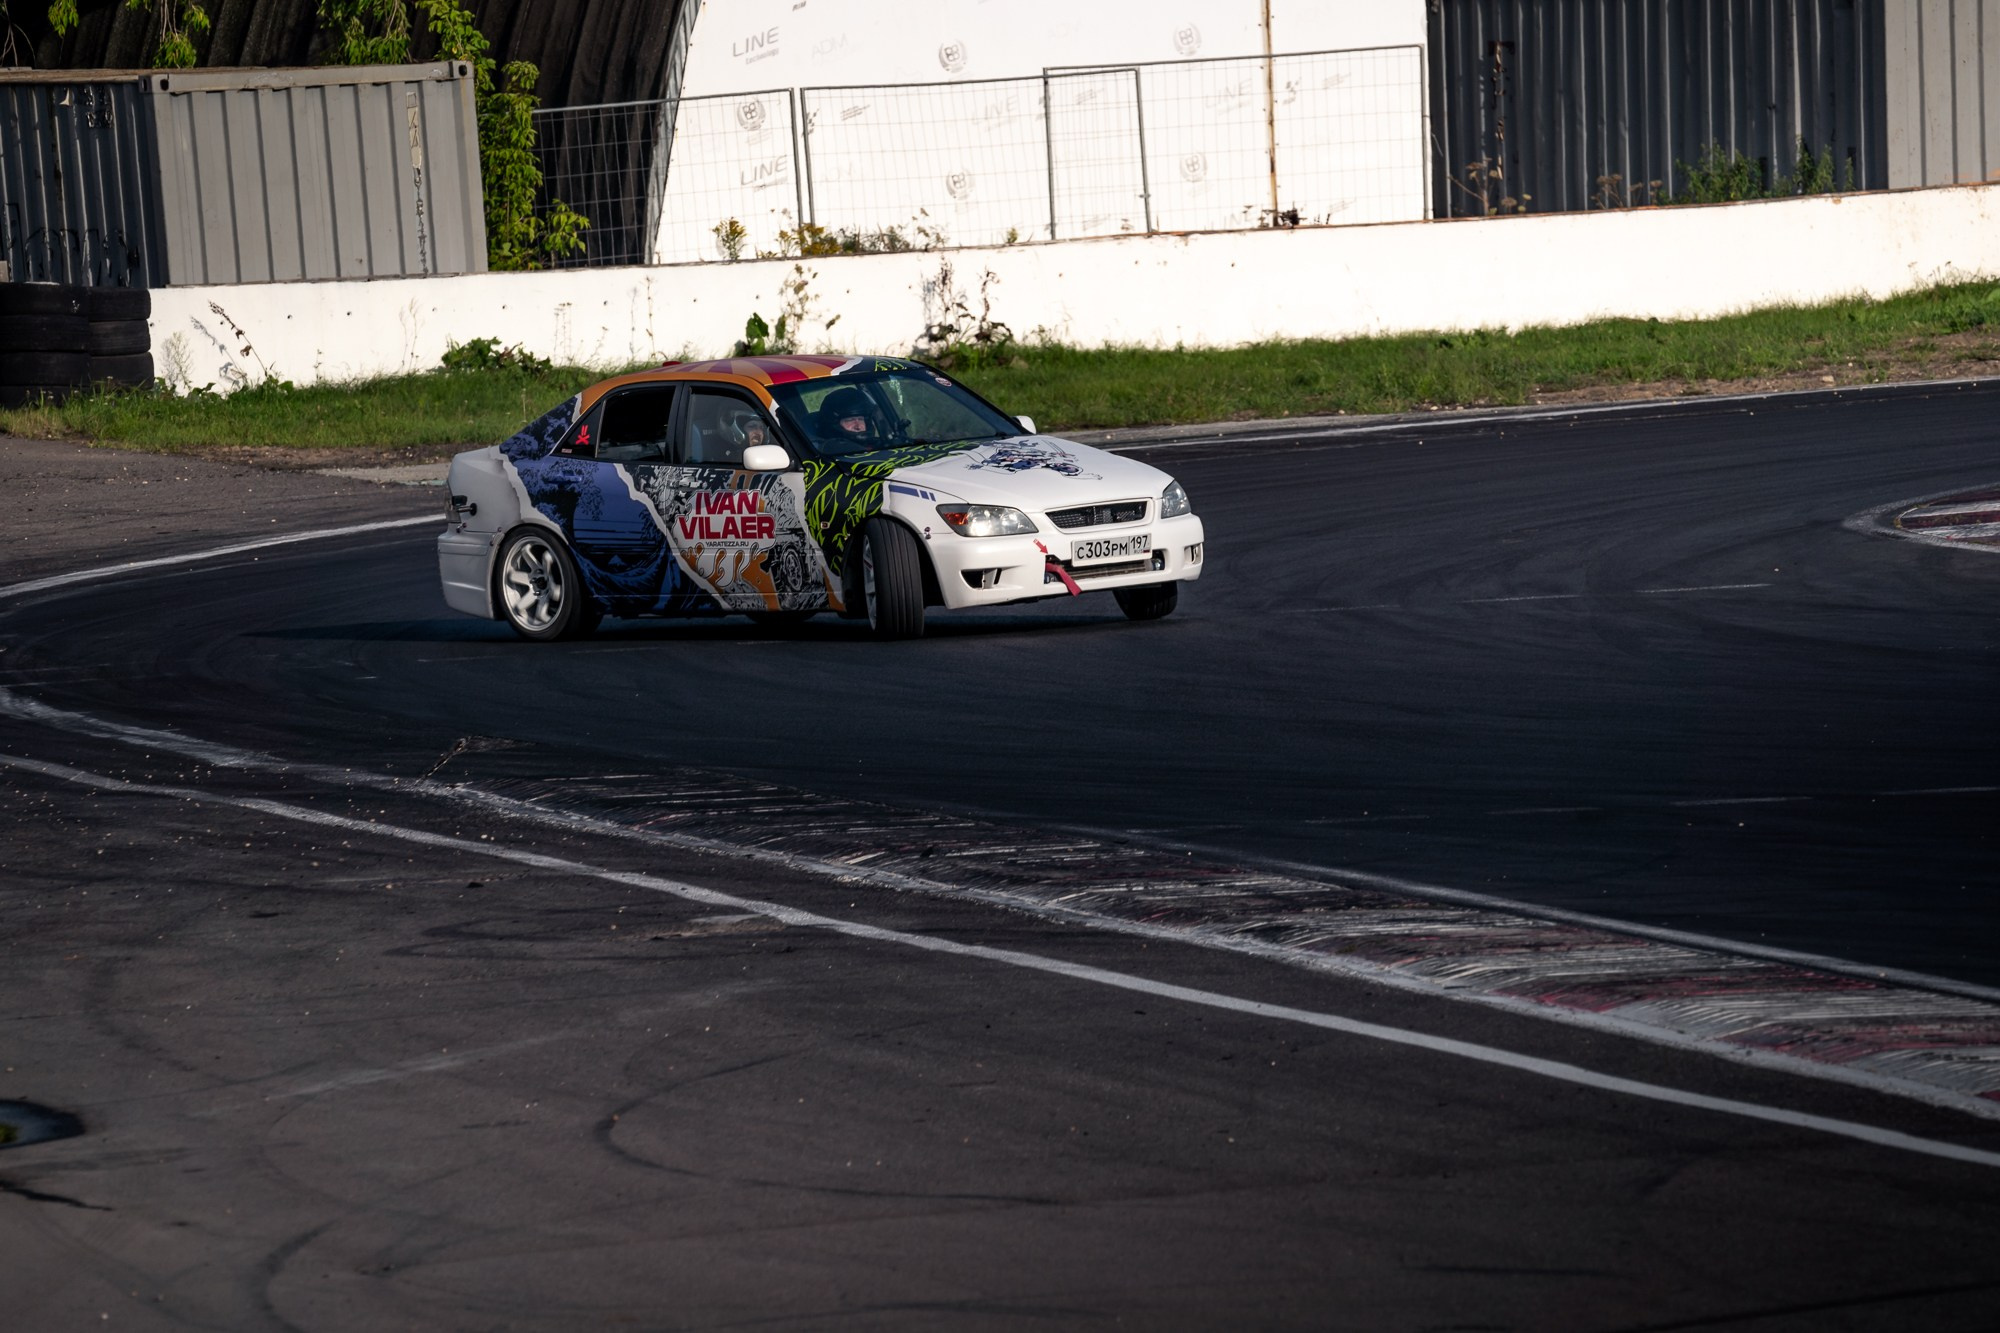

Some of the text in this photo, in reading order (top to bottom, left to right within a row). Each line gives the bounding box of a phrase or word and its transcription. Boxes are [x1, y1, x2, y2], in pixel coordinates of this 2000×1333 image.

[733, 26, 779, 57] LINE
[972, 94, 1018, 125] LINE
[741, 154, 787, 185] LINE
[696, 492, 759, 514] IVAN
[679, 516, 775, 539] VILAER
[1131, 535, 1148, 549] 197
